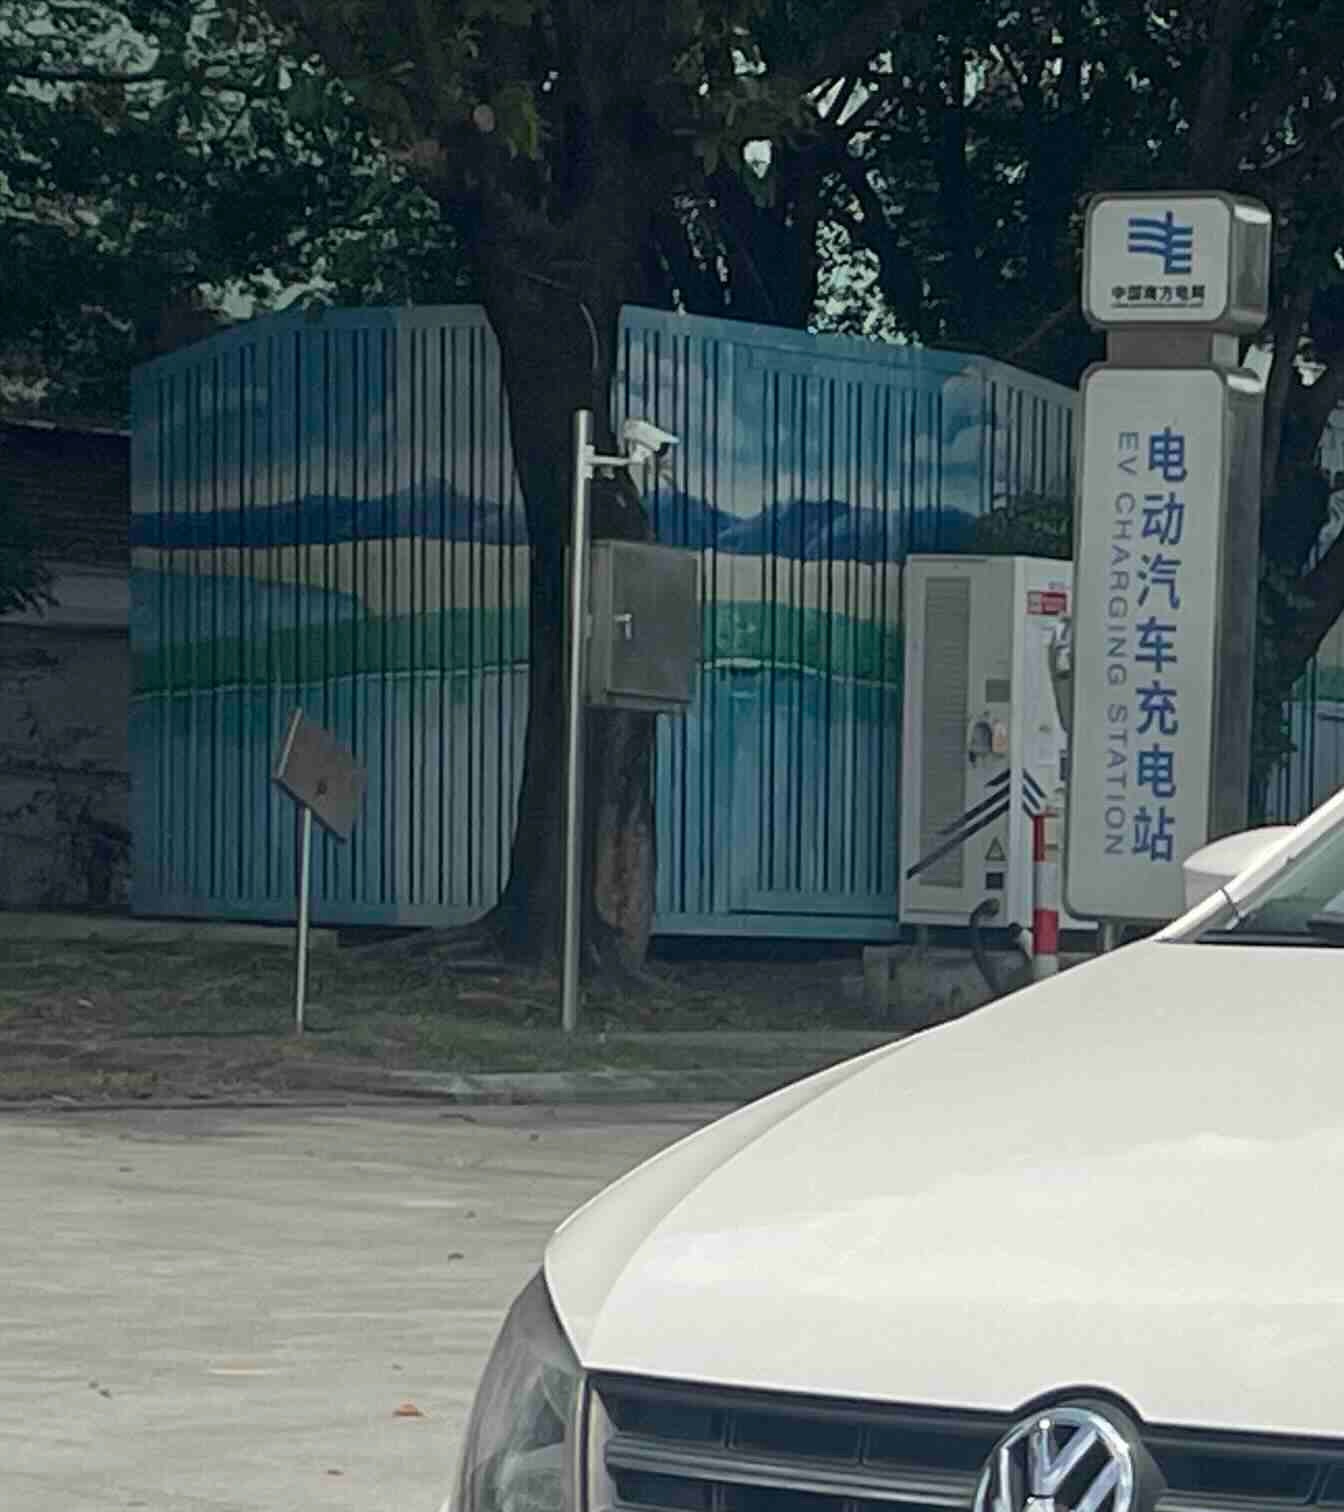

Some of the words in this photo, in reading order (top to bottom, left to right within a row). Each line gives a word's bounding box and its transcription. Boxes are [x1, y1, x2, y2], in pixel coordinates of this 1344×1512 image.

[1117, 431, 1138, 476] EV
[1107, 492, 1136, 686] CHARGING
[1131, 426, 1187, 862] 电动汽车充电站
[1104, 703, 1128, 855] STATION
